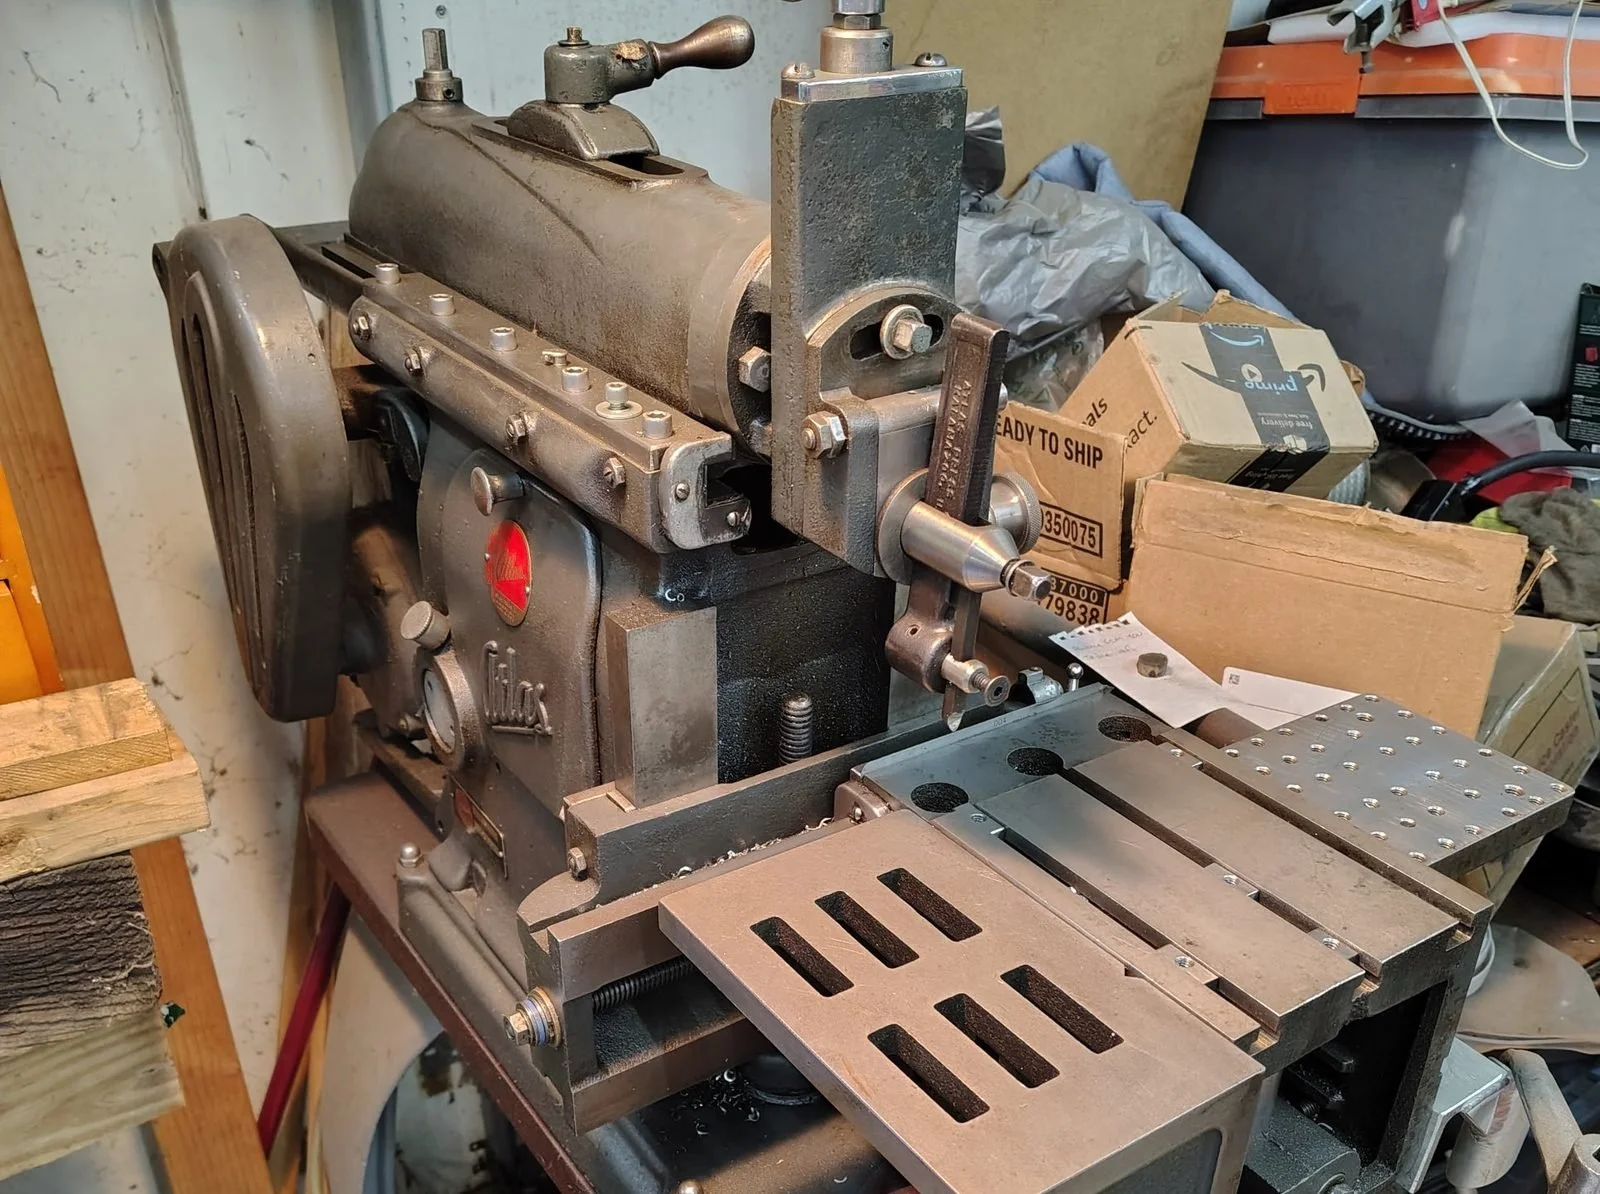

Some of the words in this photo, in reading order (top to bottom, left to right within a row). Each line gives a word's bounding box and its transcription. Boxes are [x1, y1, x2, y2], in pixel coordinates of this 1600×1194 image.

[1244, 374, 1298, 396] prime
[1082, 397, 1108, 427] als
[1260, 416, 1294, 429] delivery
[1294, 419, 1314, 430] free
[996, 415, 1035, 446] EADY
[1038, 427, 1059, 456] TO
[1064, 437, 1103, 469] SHIP
[1127, 409, 1158, 449] act.
[1040, 507, 1096, 548] 350075
[1038, 594, 1100, 626] 79838
